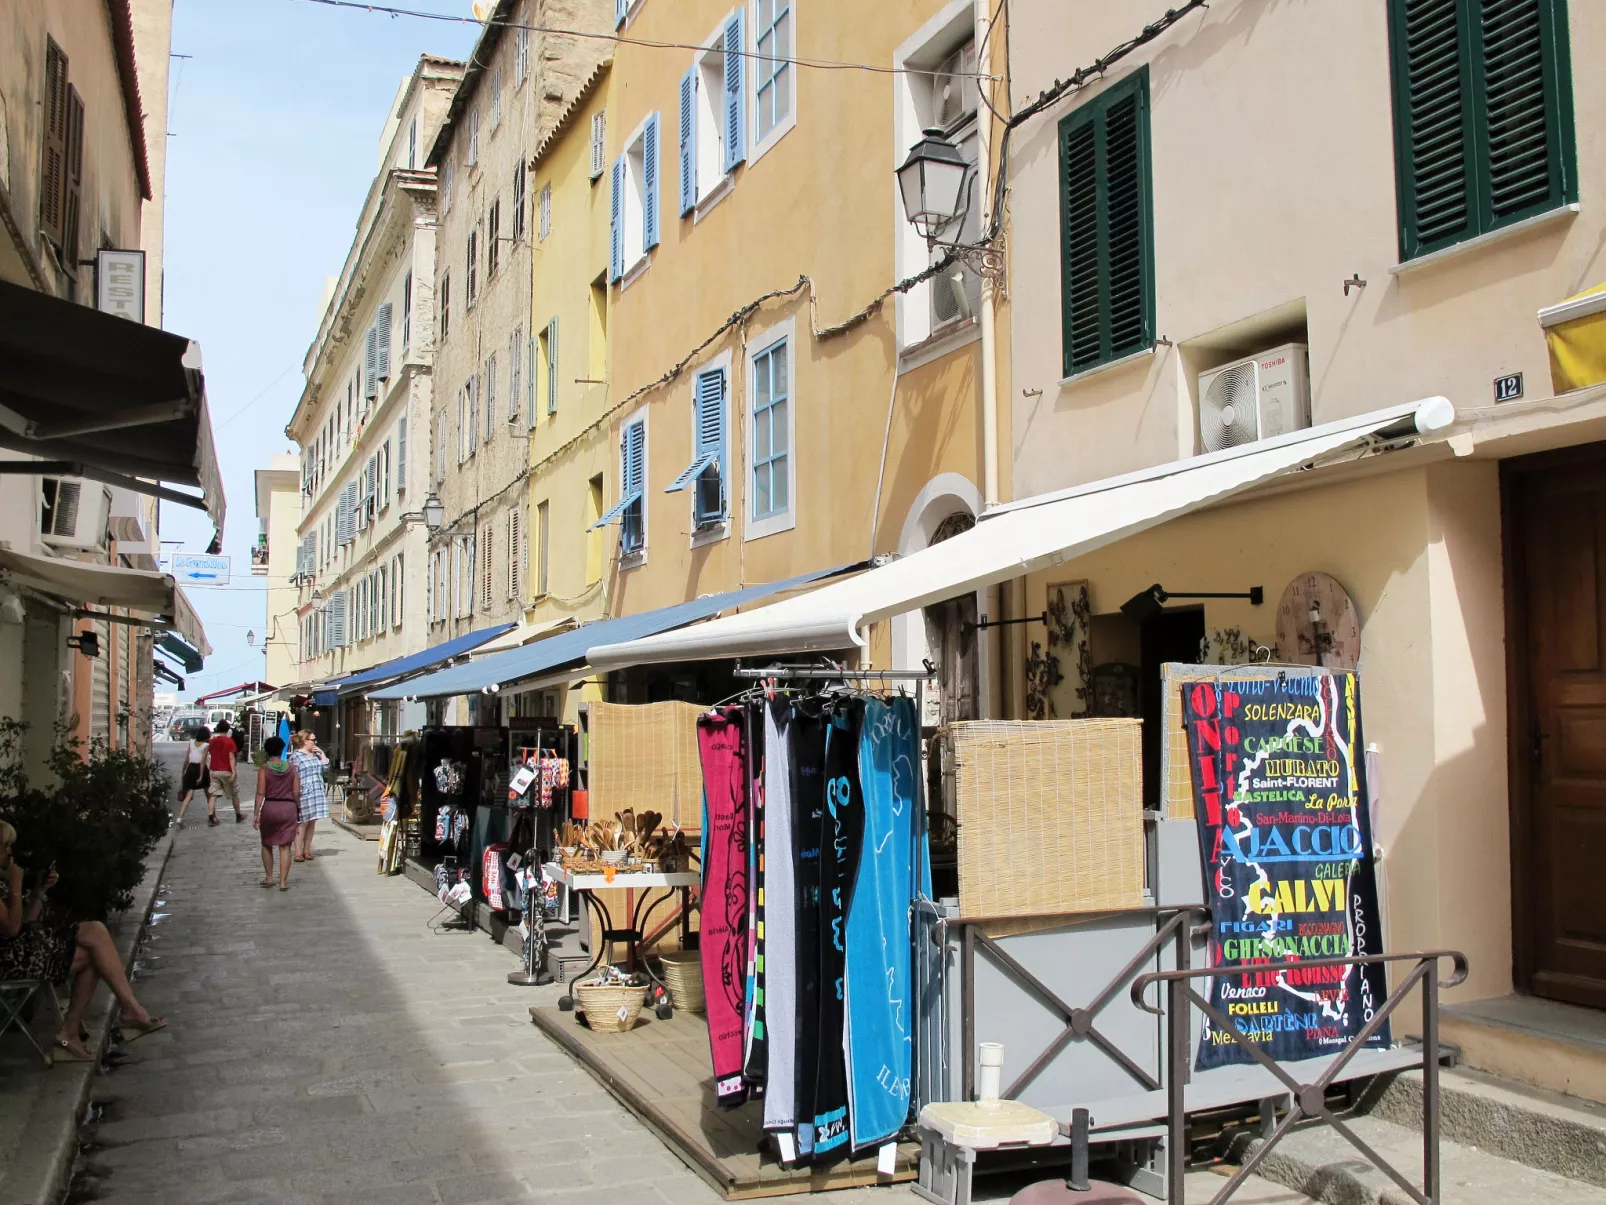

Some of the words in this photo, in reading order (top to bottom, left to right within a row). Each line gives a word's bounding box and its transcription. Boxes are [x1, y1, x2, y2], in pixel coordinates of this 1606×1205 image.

[1261, 357, 1285, 370] TOSHIBA
[1500, 377, 1517, 398] 12
[1308, 576, 1316, 588] 12
[1244, 702, 1320, 721] SOLENZARA
[1243, 732, 1325, 754] CARGÈSE
[1223, 691, 1241, 827] Porto
[1265, 759, 1339, 777] MURATO
[1252, 777, 1339, 789] Saint-FLORENT
[1233, 790, 1306, 803] BASTELICA
[1305, 793, 1323, 809] La
[1221, 824, 1362, 863] AJACCIO
[1248, 878, 1346, 915] CALVI
[1220, 919, 1293, 933] FIGARI
[1223, 933, 1351, 960] GHISONACCIA
[1221, 983, 1266, 999] Venaco
[1228, 1001, 1278, 1016] FOLLELI
[1234, 1007, 1318, 1034] SARTÈNE
[1306, 1026, 1339, 1040] PIANA
